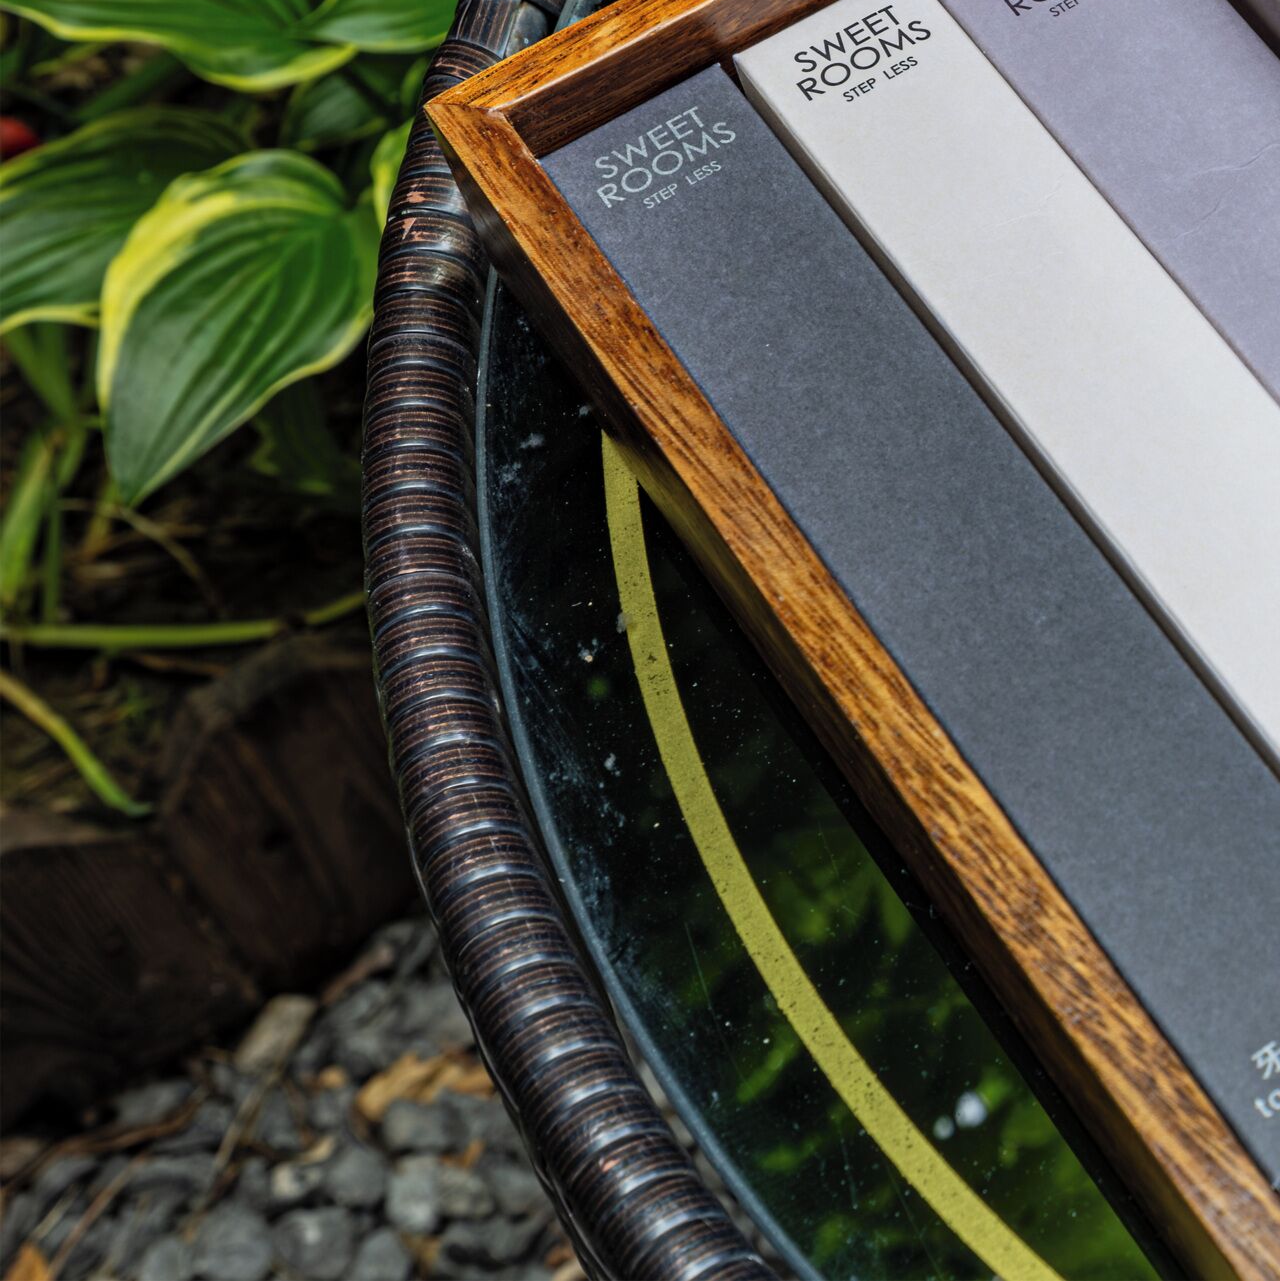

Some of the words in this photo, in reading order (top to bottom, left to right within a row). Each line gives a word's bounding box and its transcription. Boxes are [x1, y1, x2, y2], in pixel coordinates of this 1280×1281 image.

[794, 4, 900, 73] SWEET
[796, 20, 932, 102] ROOMS
[842, 77, 877, 102] STEP
[883, 56, 918, 80] LESS
[595, 106, 704, 179] SWEET
[597, 121, 736, 208] ROOMS
[643, 183, 678, 209] STEP
[685, 160, 722, 185] LESS
